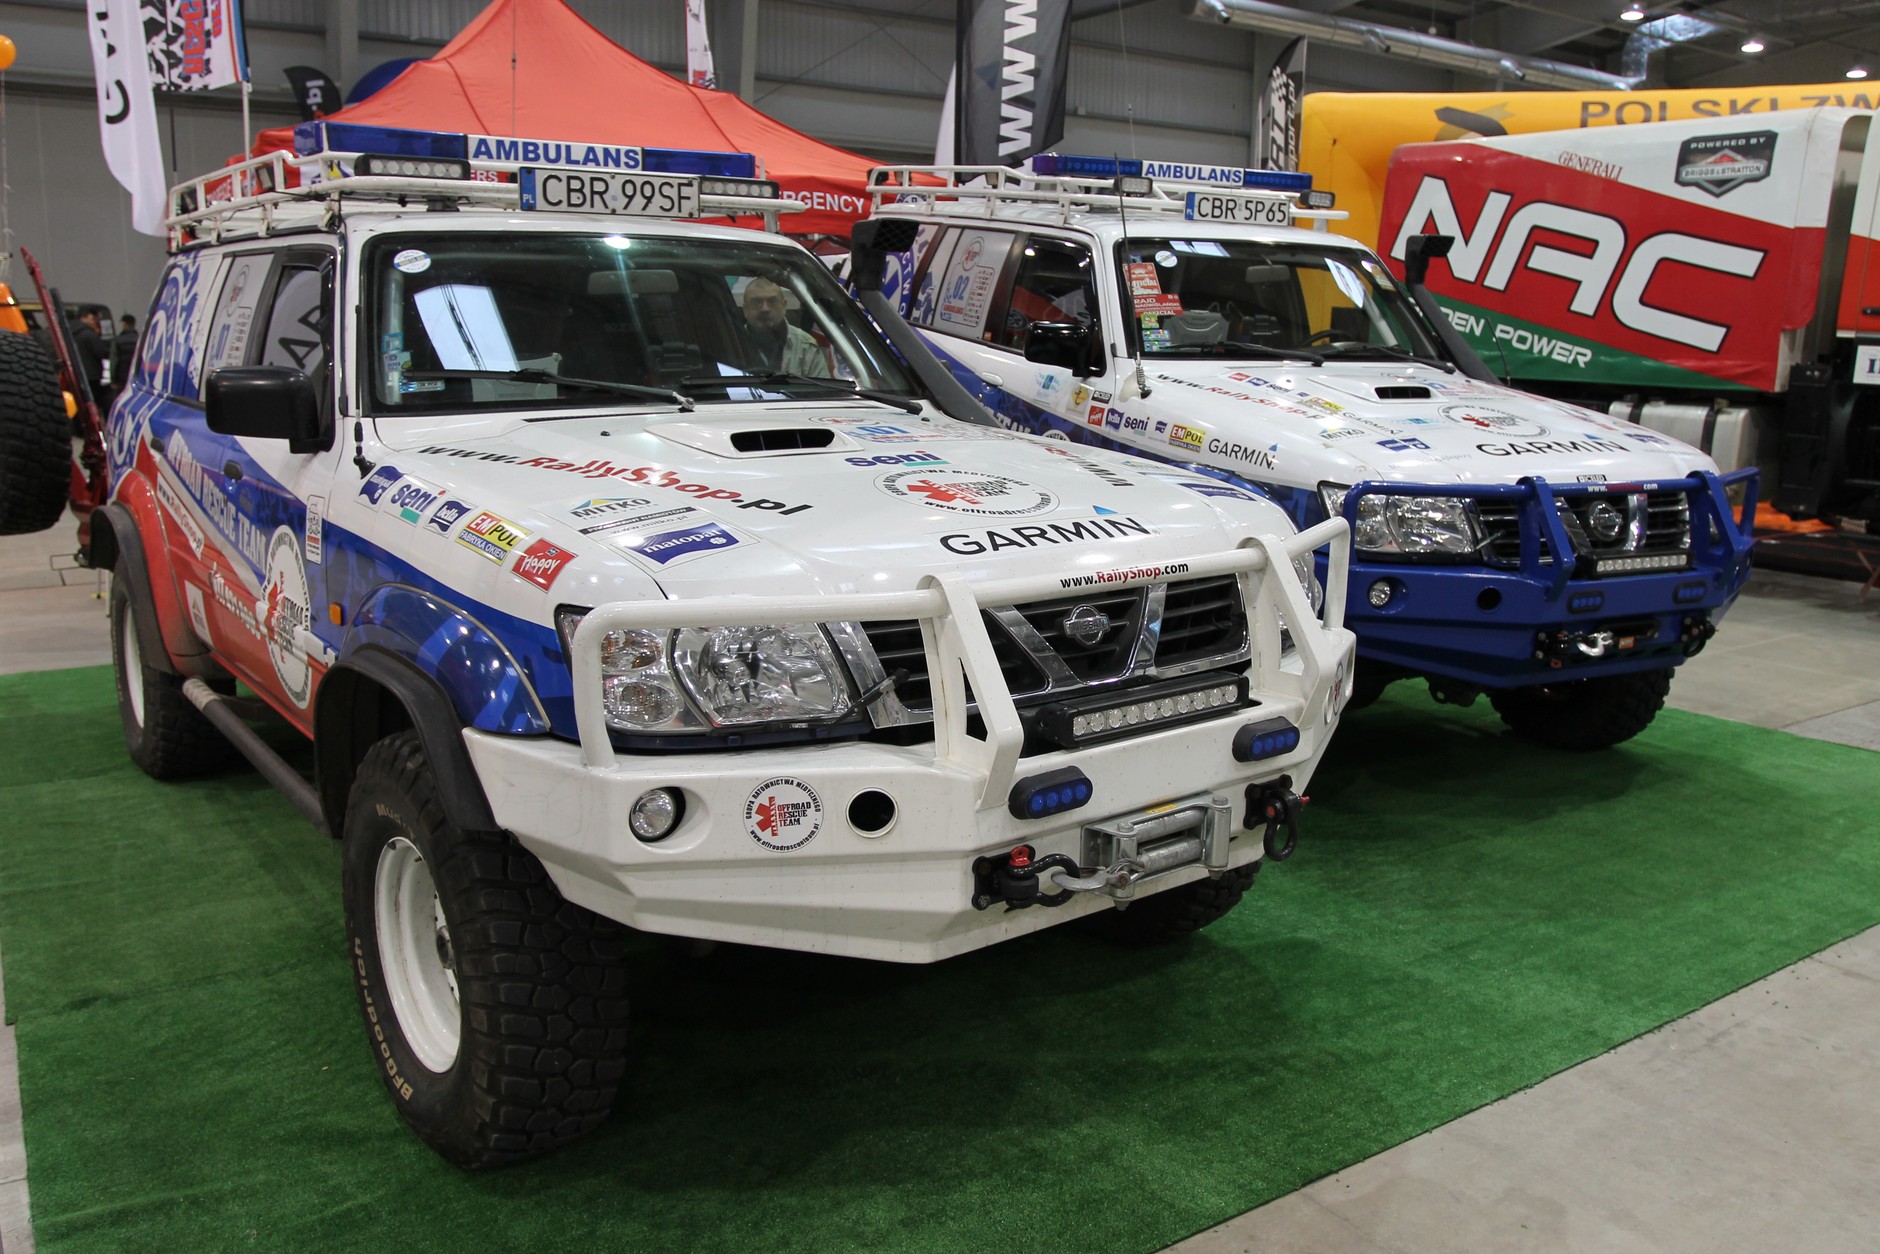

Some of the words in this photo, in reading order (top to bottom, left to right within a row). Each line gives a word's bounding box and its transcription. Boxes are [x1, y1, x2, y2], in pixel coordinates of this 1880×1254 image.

[472, 138, 641, 169] AMBULANS
[1690, 138, 1747, 149] POWERED
[1750, 136, 1767, 146] BY
[1144, 163, 1243, 183] AMBULANS
[1558, 151, 1625, 181] GENERALI
[522, 193, 535, 204] PL
[541, 174, 610, 210] CBR
[621, 179, 694, 214] 99SF
[1197, 197, 1237, 221] CBR
[1243, 200, 1287, 223] 5P65
[1390, 174, 1768, 353] NAC
[1492, 324, 1593, 369] POWER
[1124, 417, 1151, 432] seni
[844, 450, 943, 467] seni
[1476, 441, 1631, 456] GARMIN
[416, 446, 813, 517] www.RallyShop.pl
[390, 484, 447, 513] seni
[570, 498, 652, 520] MITKO
[459, 530, 486, 552] FABRYKA
[485, 543, 506, 561] OKIEN
[643, 528, 724, 554] matopat
[939, 516, 1153, 556] GARMIN
[1060, 561, 1190, 589] www.RallyShop.com
[745, 800, 756, 820] GRUPA
[753, 778, 795, 800] RATOWNICTWA
[795, 781, 822, 813] MEDYCZNEGO
[777, 801, 812, 812] OFFROAD
[777, 809, 809, 820] RESCUE
[778, 817, 802, 827] TEAM
[749, 823, 821, 852] www.offroadrescueteam.pl
